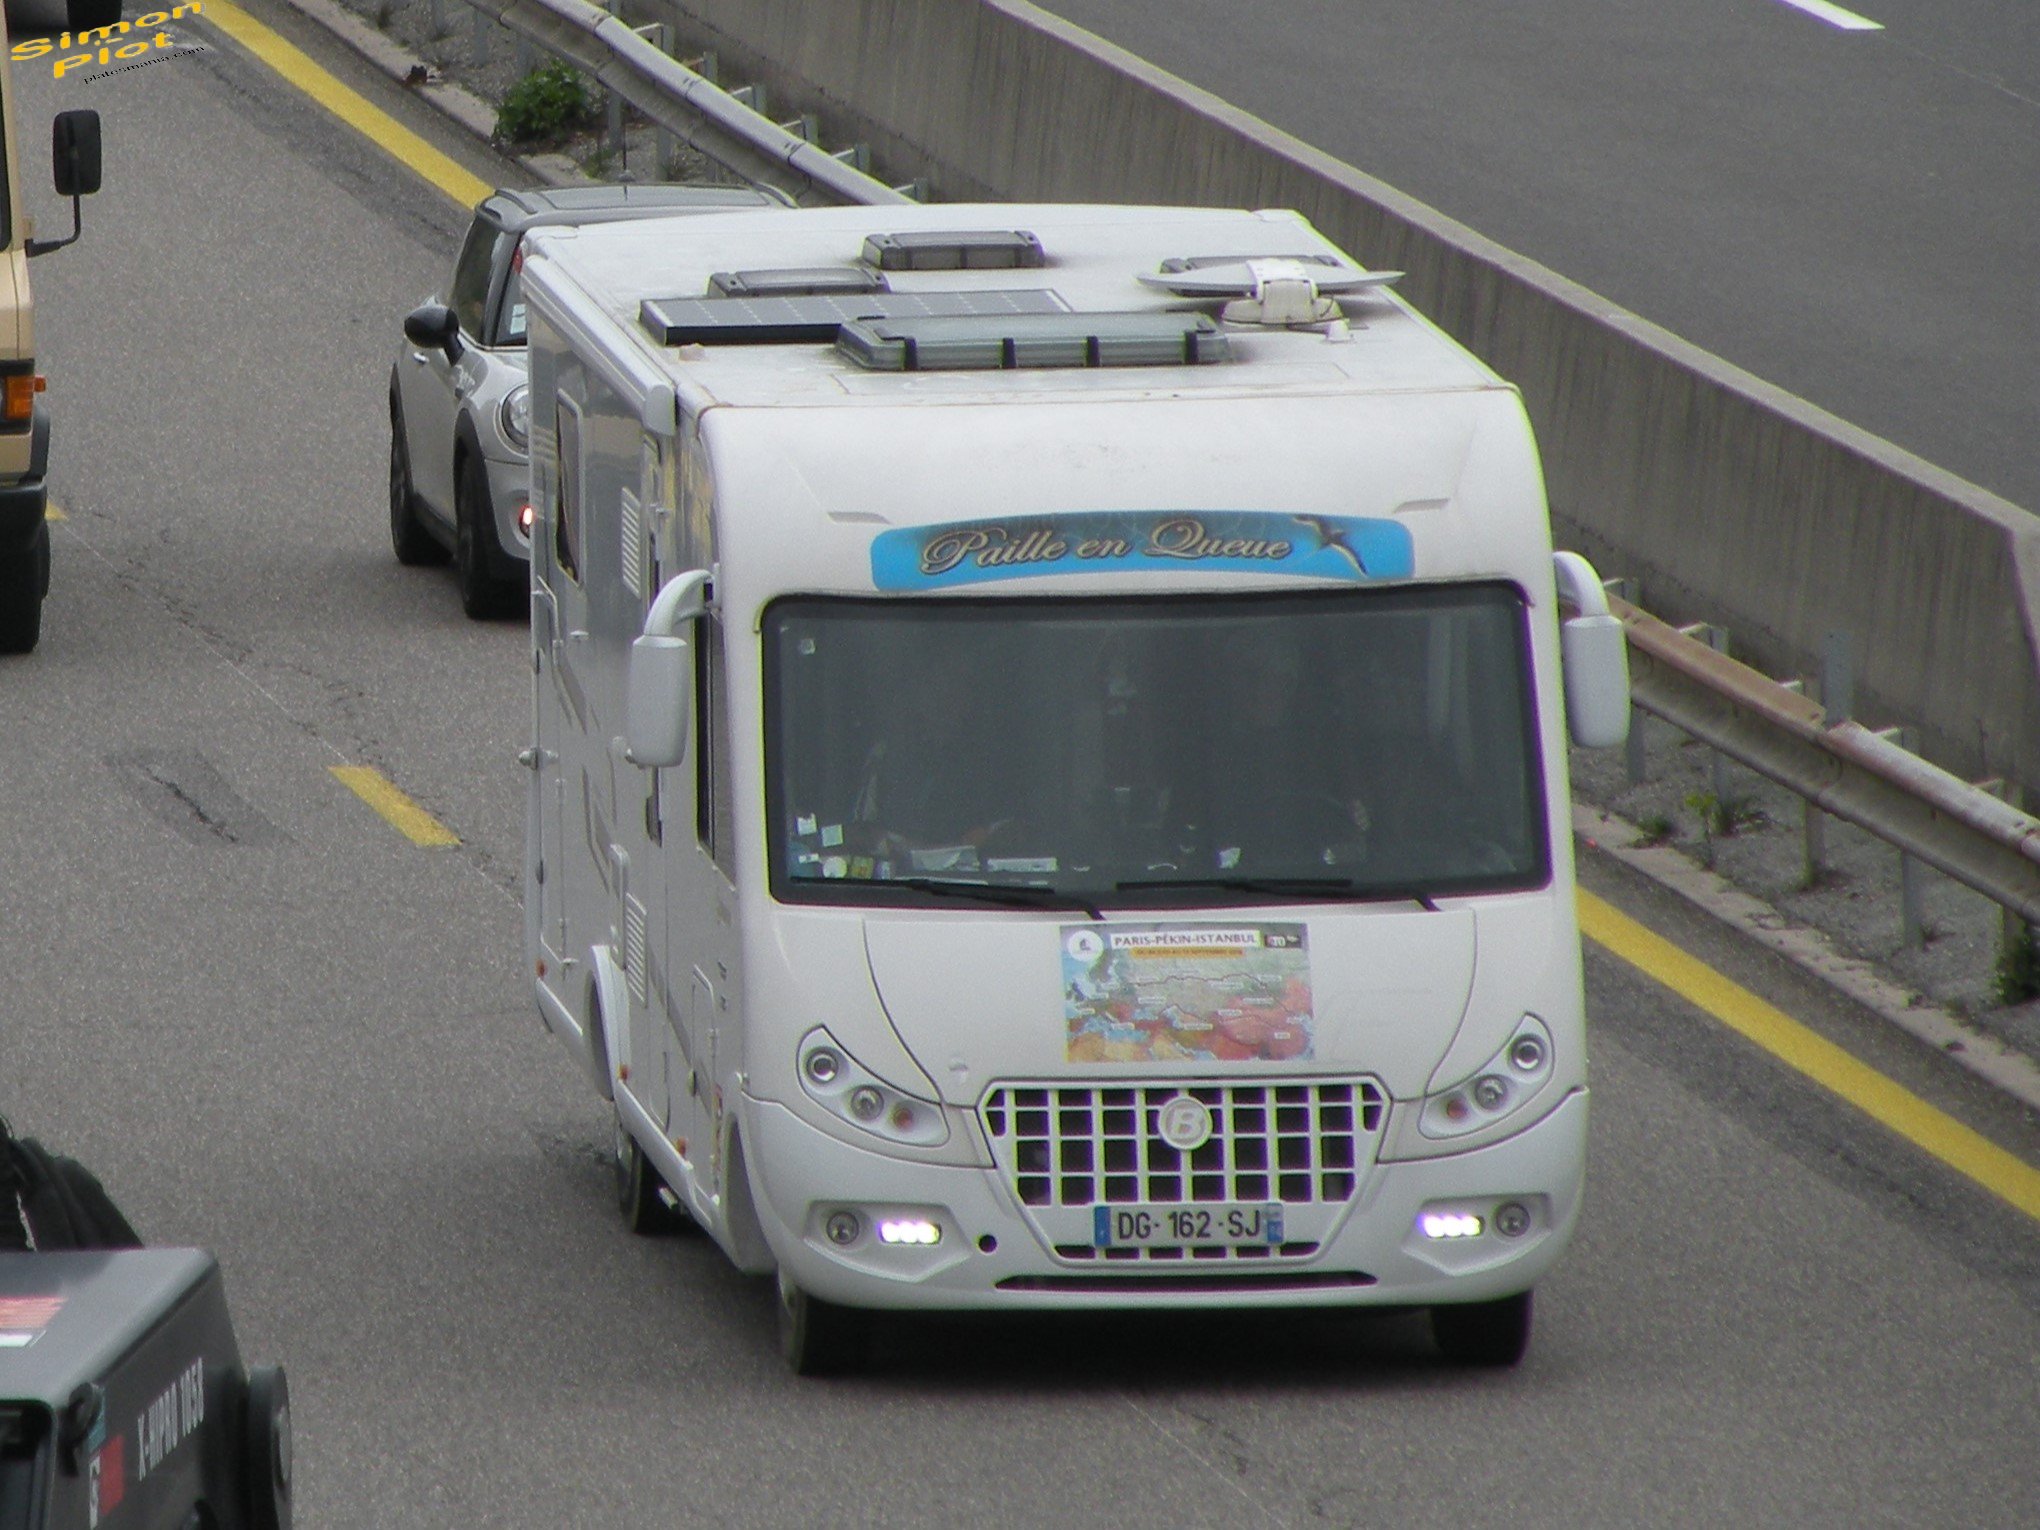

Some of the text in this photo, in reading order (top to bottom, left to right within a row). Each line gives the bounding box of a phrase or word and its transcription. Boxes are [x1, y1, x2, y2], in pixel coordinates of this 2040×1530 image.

[920, 519, 1294, 576] Paille en Queue
